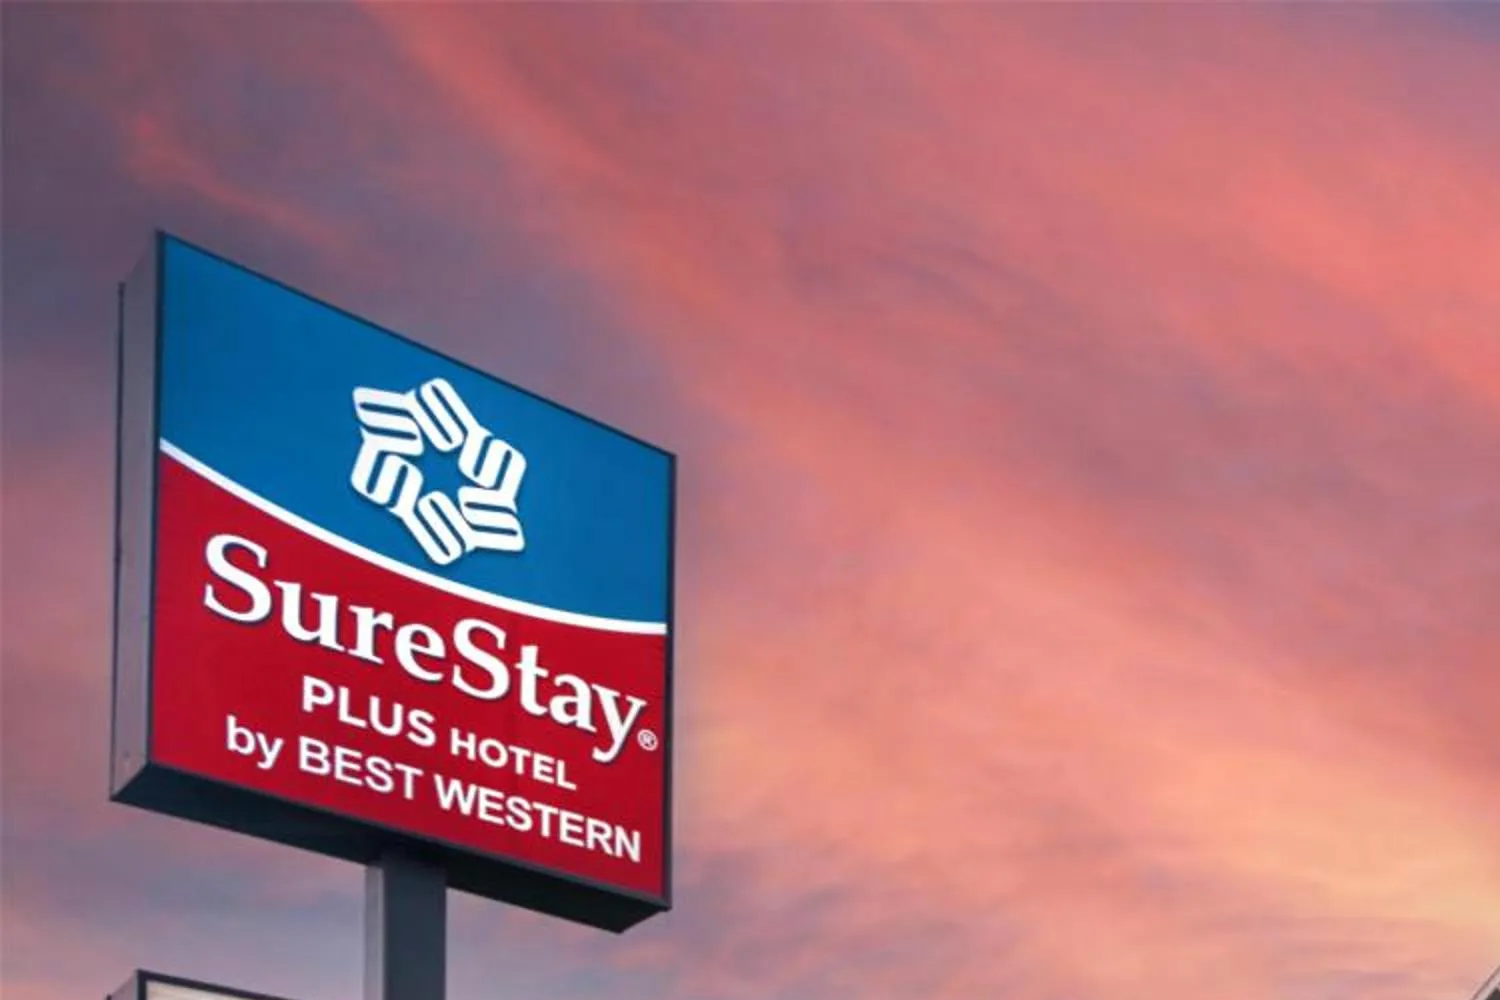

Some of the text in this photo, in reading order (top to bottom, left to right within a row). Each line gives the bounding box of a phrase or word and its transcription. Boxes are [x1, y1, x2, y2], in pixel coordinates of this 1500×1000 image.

[226, 715, 641, 862] by BEST WESTERN
[302, 675, 577, 790] PLUS HOTEL
